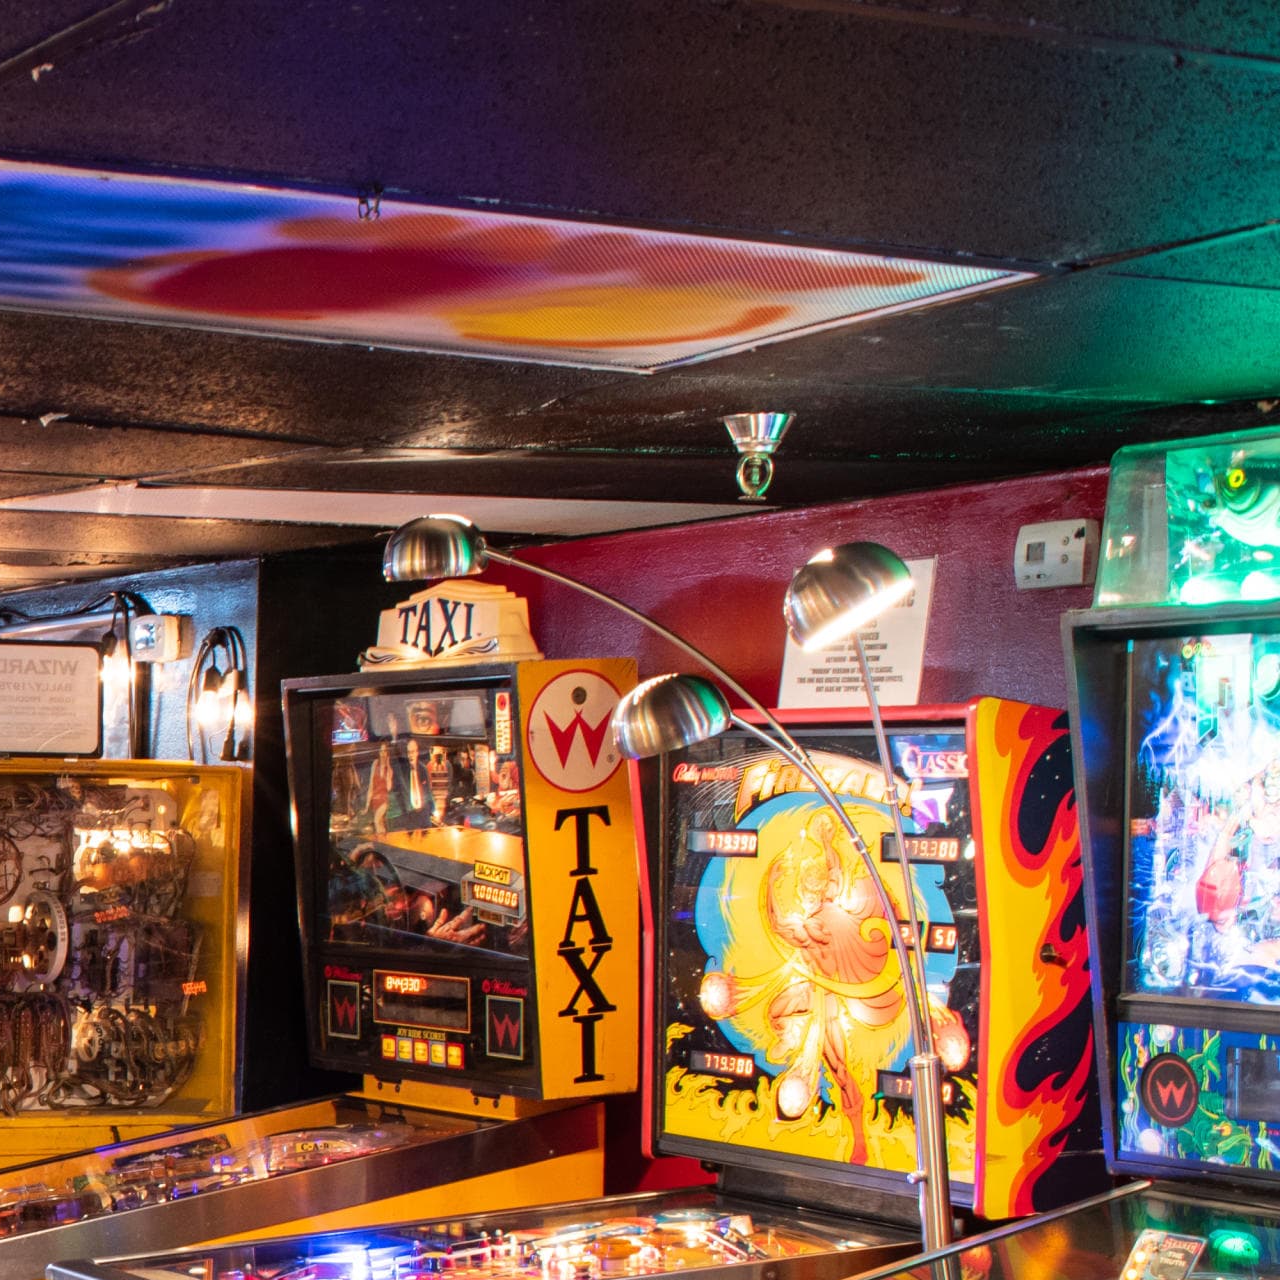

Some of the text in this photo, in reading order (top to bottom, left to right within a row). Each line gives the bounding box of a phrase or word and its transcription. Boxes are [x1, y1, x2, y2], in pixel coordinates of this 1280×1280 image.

[397, 597, 475, 659] TAXI
[672, 762, 701, 785] Bally
[476, 862, 510, 882] JACKPOT
[553, 804, 618, 1084] TAXI
[934, 926, 957, 946] 50
[1159, 1257, 1187, 1267] TRUTH
[1166, 1250, 1186, 1260] THE
